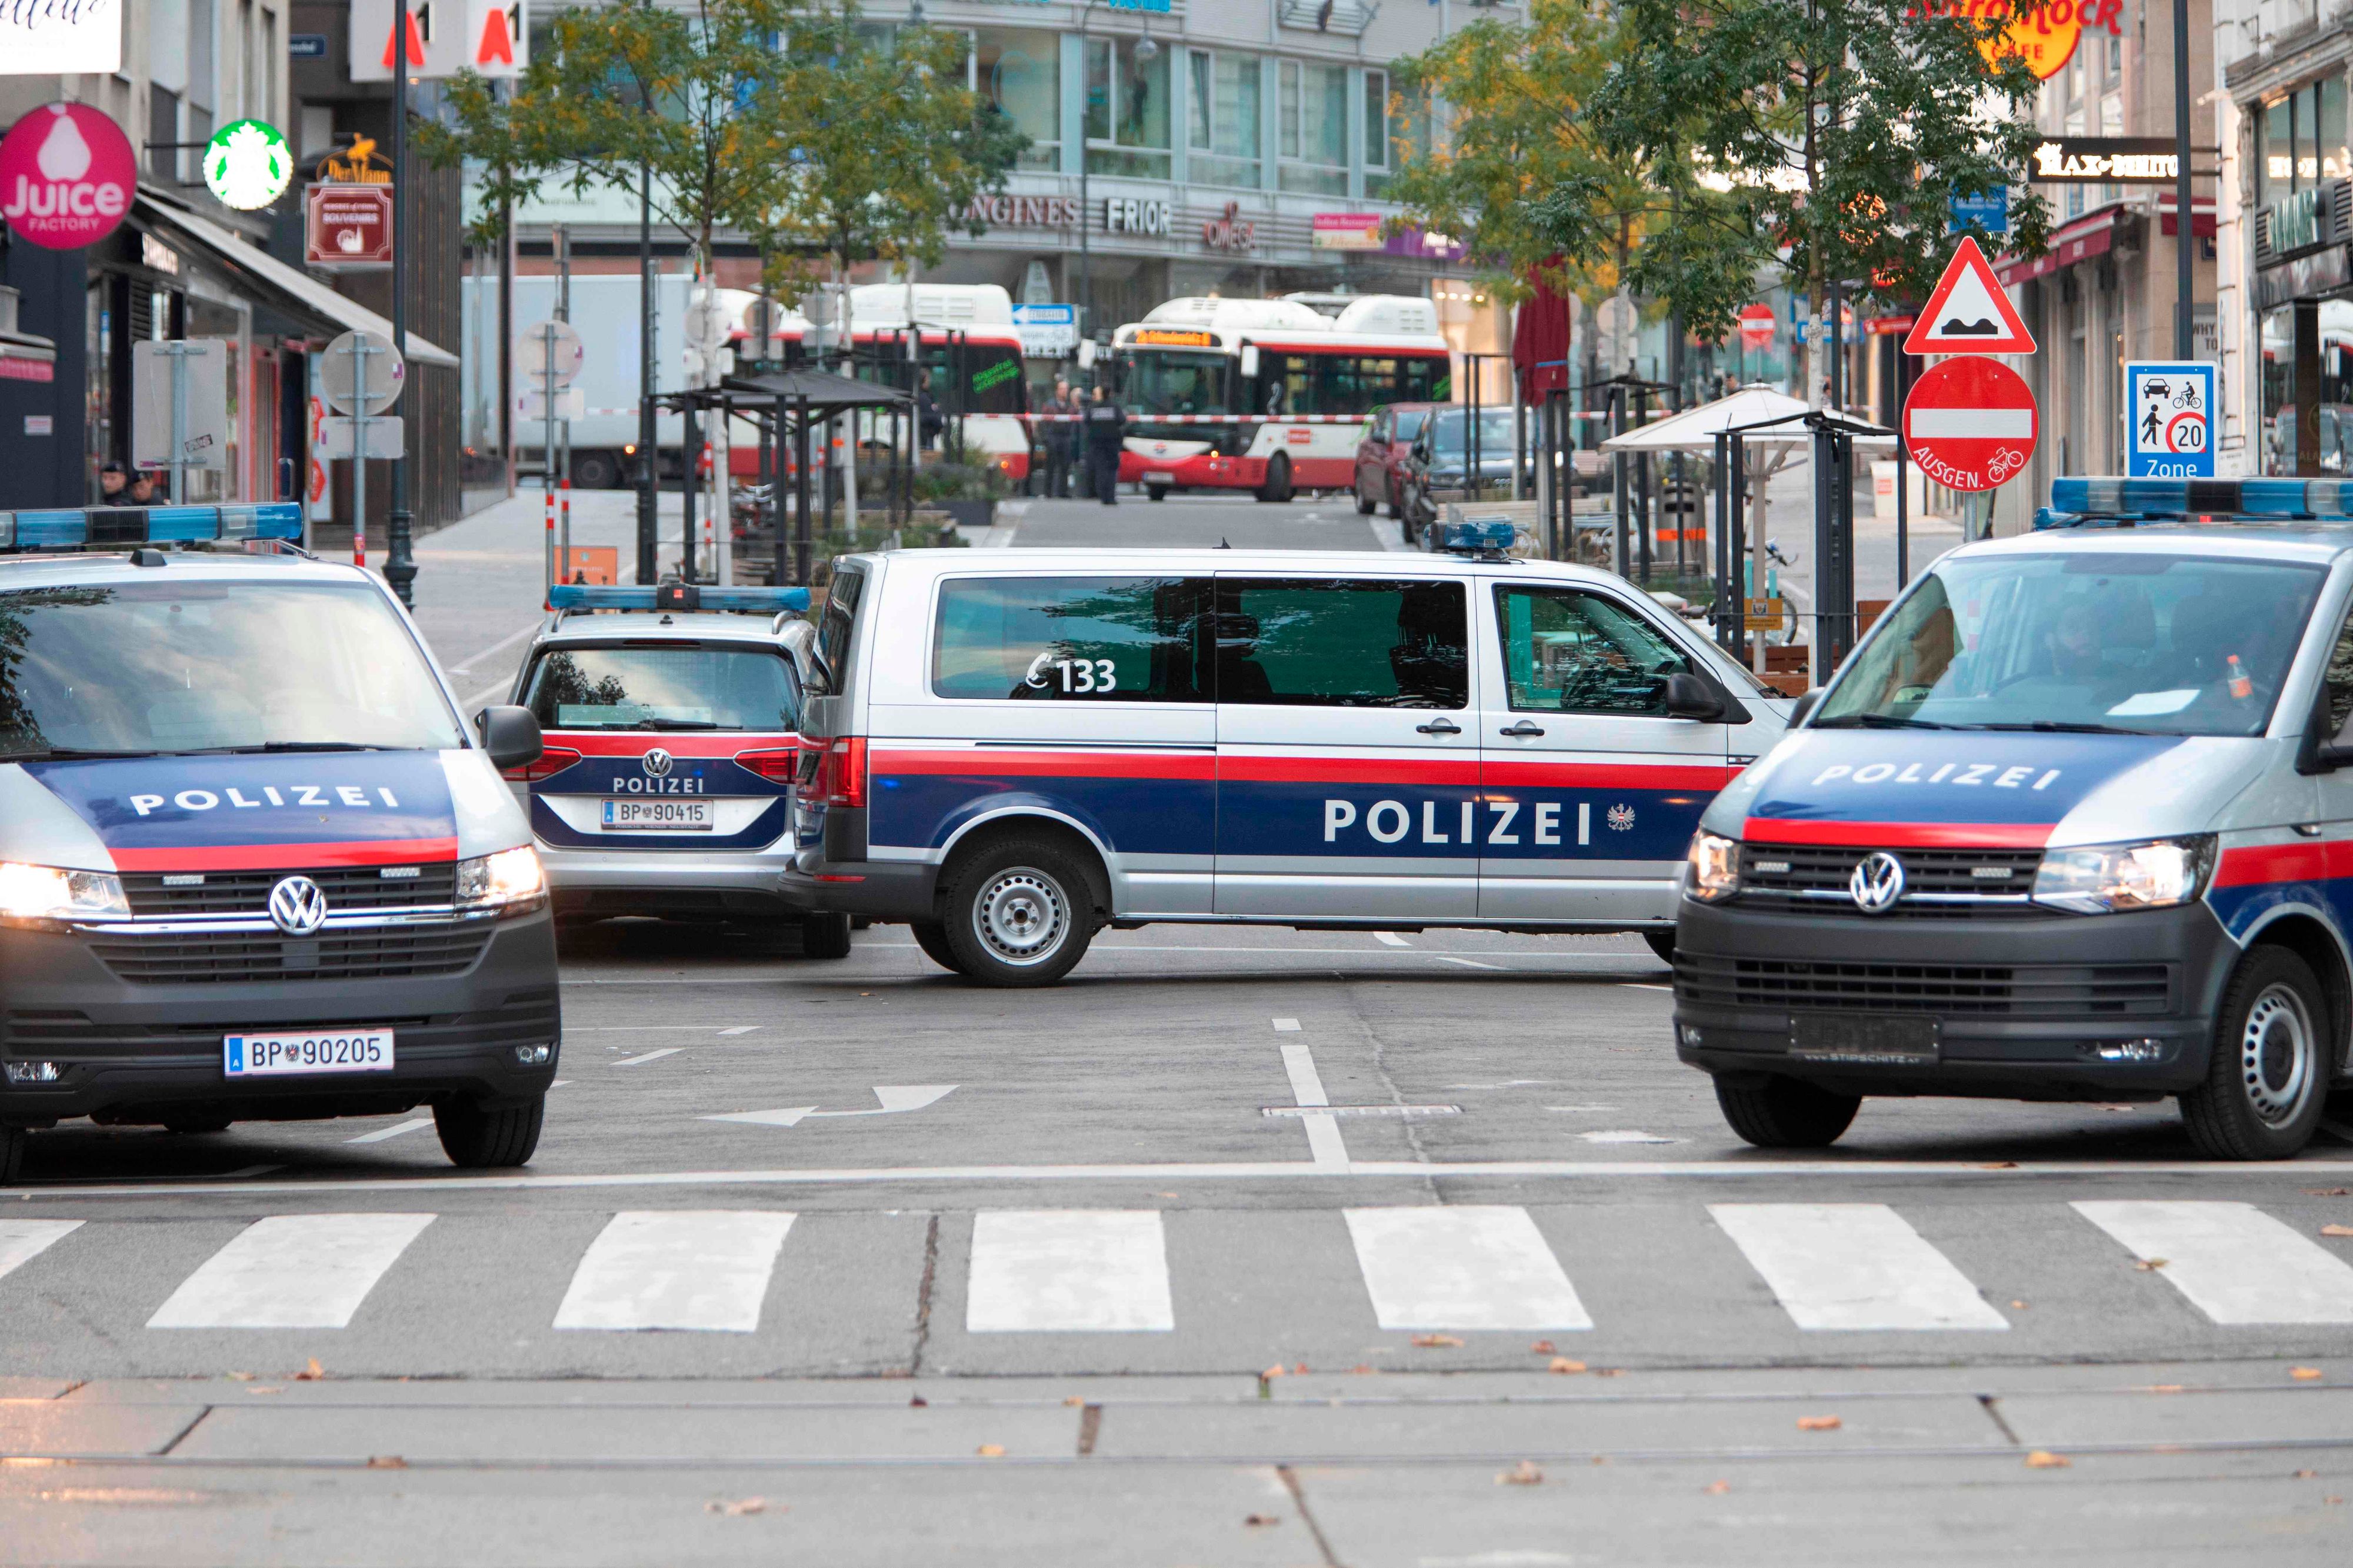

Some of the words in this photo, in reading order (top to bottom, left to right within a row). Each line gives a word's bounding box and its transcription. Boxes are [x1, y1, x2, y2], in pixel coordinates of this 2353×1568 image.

[28, 218, 99, 231] FACTORY
[2178, 425, 2201, 447] 20
[1913, 446, 1984, 488] AUSGEN.
[2146, 459, 2198, 478] Zone
[1056, 659, 1116, 693] 133
[612, 777, 704, 793] POLIZEI
[1810, 763, 2062, 790] POLIZEI
[129, 785, 399, 816] POLIZEI
[620, 804, 641, 820] BP
[654, 804, 704, 822] 90415
[1324, 799, 1590, 846] POLIZEI
[251, 1041, 282, 1067] BP
[302, 1037, 381, 1065] 90205
